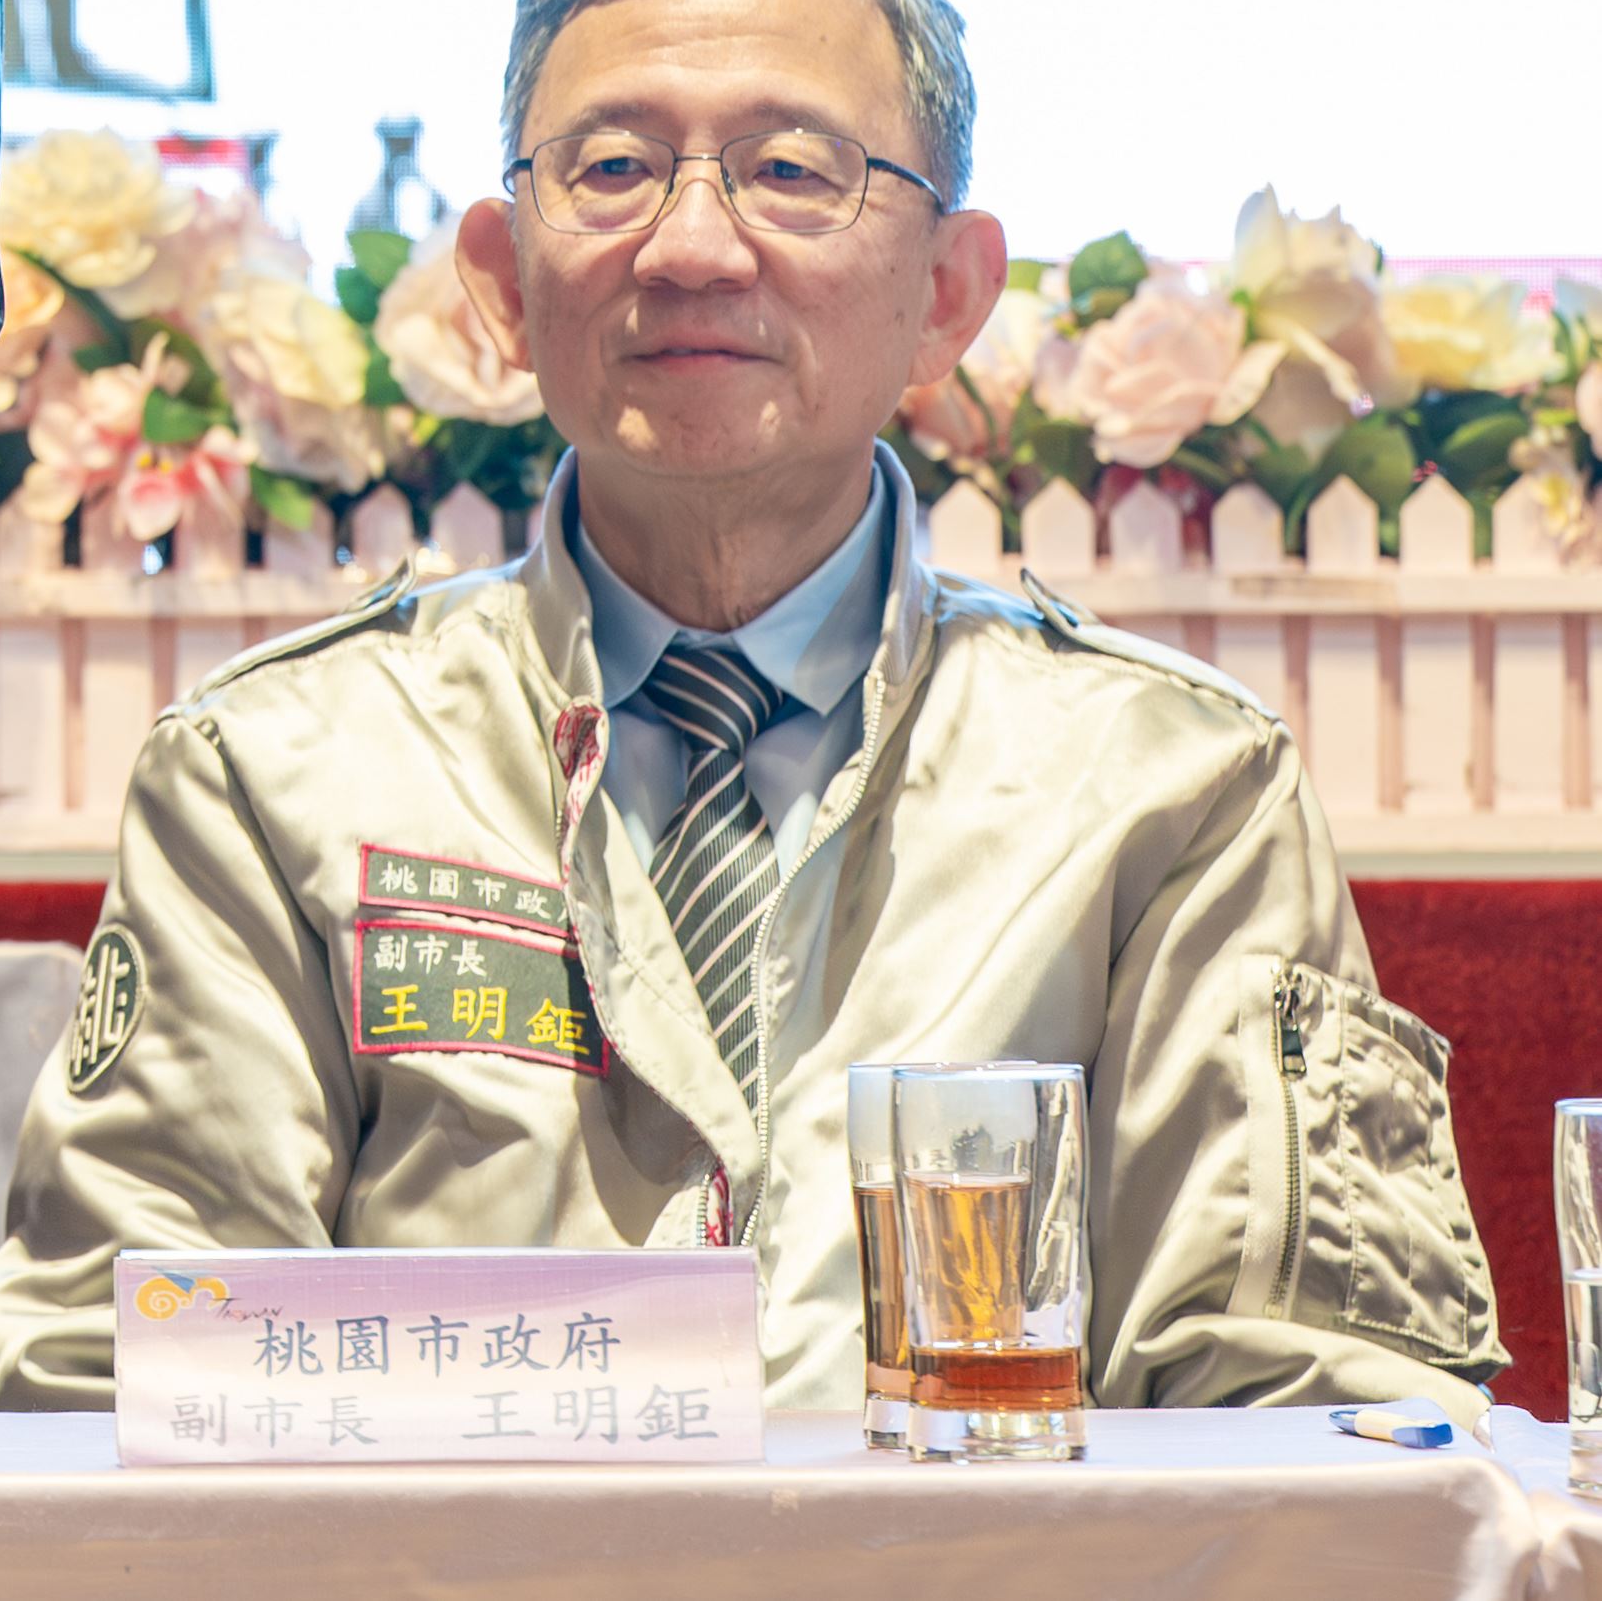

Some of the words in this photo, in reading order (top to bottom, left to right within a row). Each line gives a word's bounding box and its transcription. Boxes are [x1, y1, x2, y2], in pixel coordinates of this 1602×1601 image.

[379, 861, 569, 922] 桃園市政
[373, 933, 488, 977] 副市長
[370, 984, 590, 1056] 王明鉅
[253, 1312, 621, 1378] 桃園市政府
[169, 1394, 379, 1445] 副市長
[462, 1384, 719, 1444] 王明鉅
